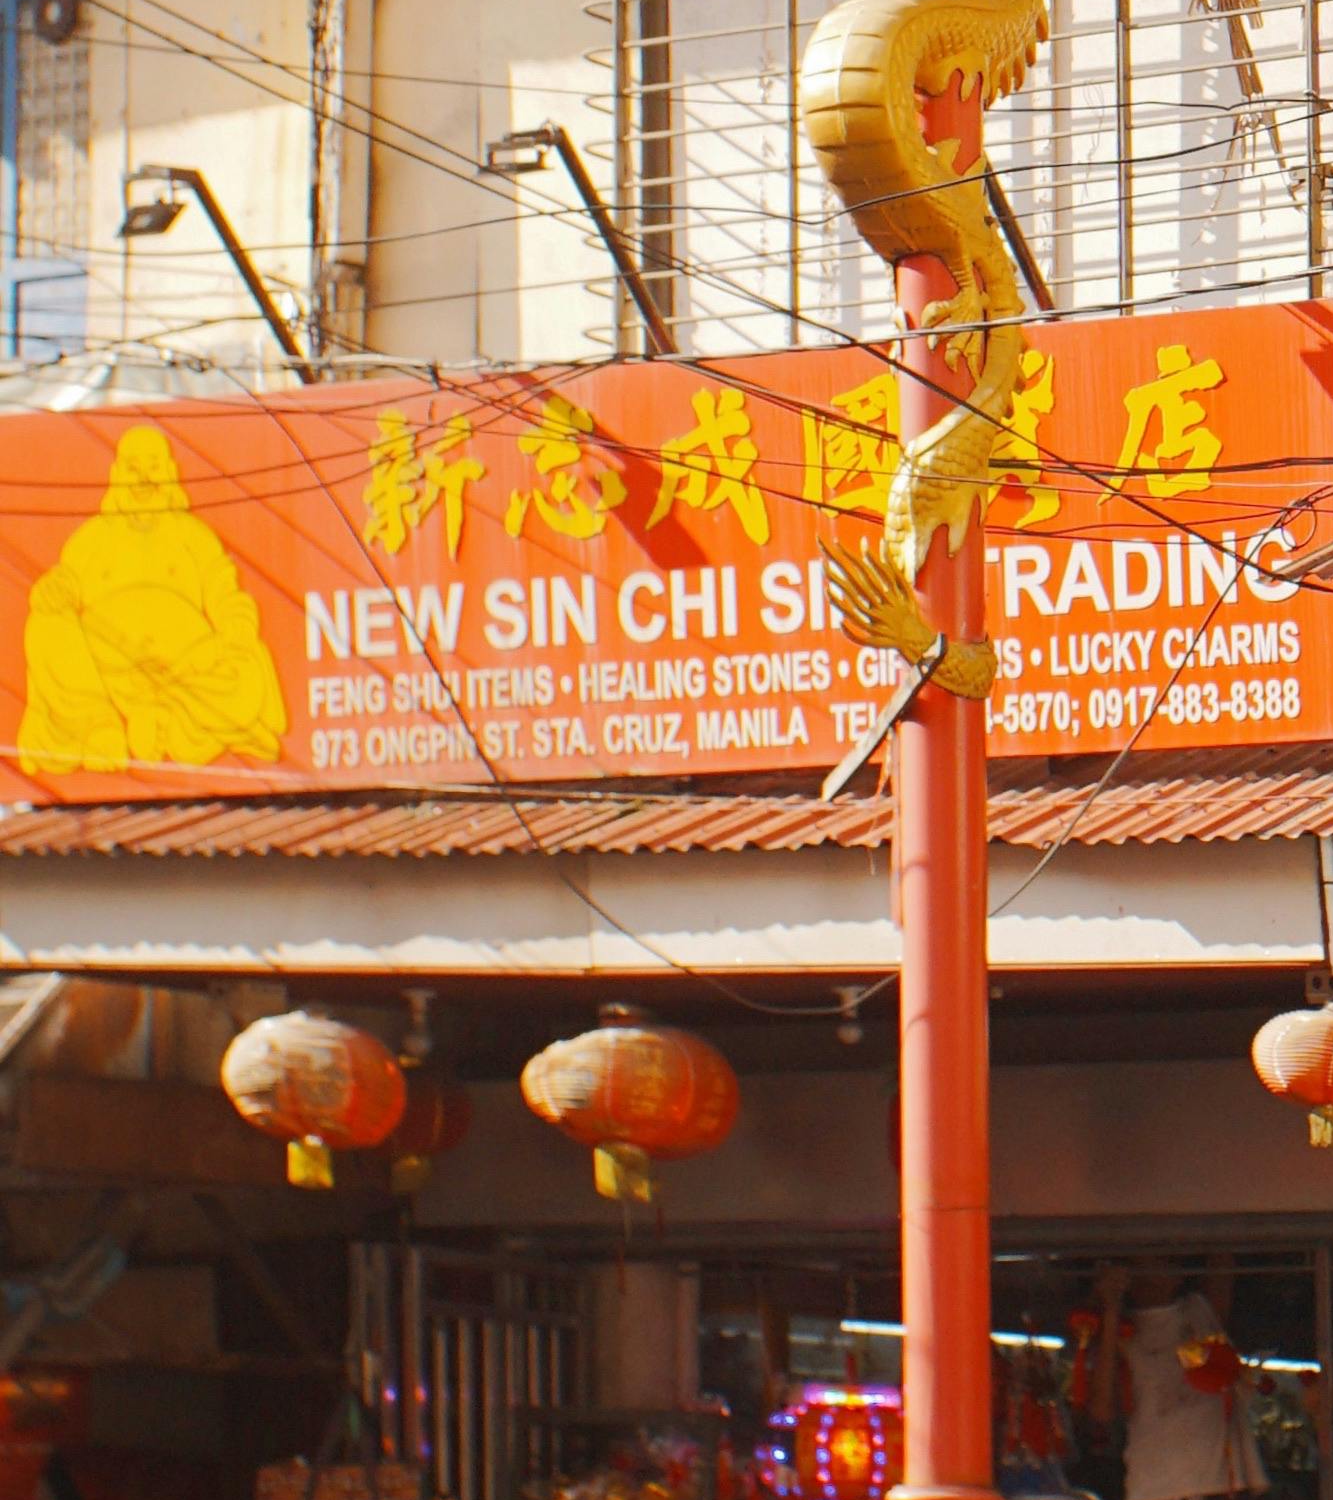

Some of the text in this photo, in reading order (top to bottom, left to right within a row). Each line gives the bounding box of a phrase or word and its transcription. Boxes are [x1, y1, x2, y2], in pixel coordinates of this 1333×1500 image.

[304, 581, 464, 661] NEW
[483, 575, 598, 650] SIN
[617, 565, 738, 644] CHI
[308, 674, 386, 718] FENG
[392, 669, 459, 714] SHUI
[466, 664, 555, 709] ITEMS
[578, 656, 707, 704] HEALING
[713, 649, 832, 698] STONES
[1050, 628, 1156, 677] LUCKY
[1162, 620, 1301, 670] CHARMS
[311, 728, 360, 769] 973
[364, 722, 478, 765] ONGPIN
[482, 720, 526, 760] ST.
[531, 717, 595, 758] STA.
[602, 713, 690, 760] CRUZ,
[696, 706, 810, 752] MANILA
[985, 690, 1080, 737] -5870;
[1088, 678, 1302, 730] 0917-883-8388
